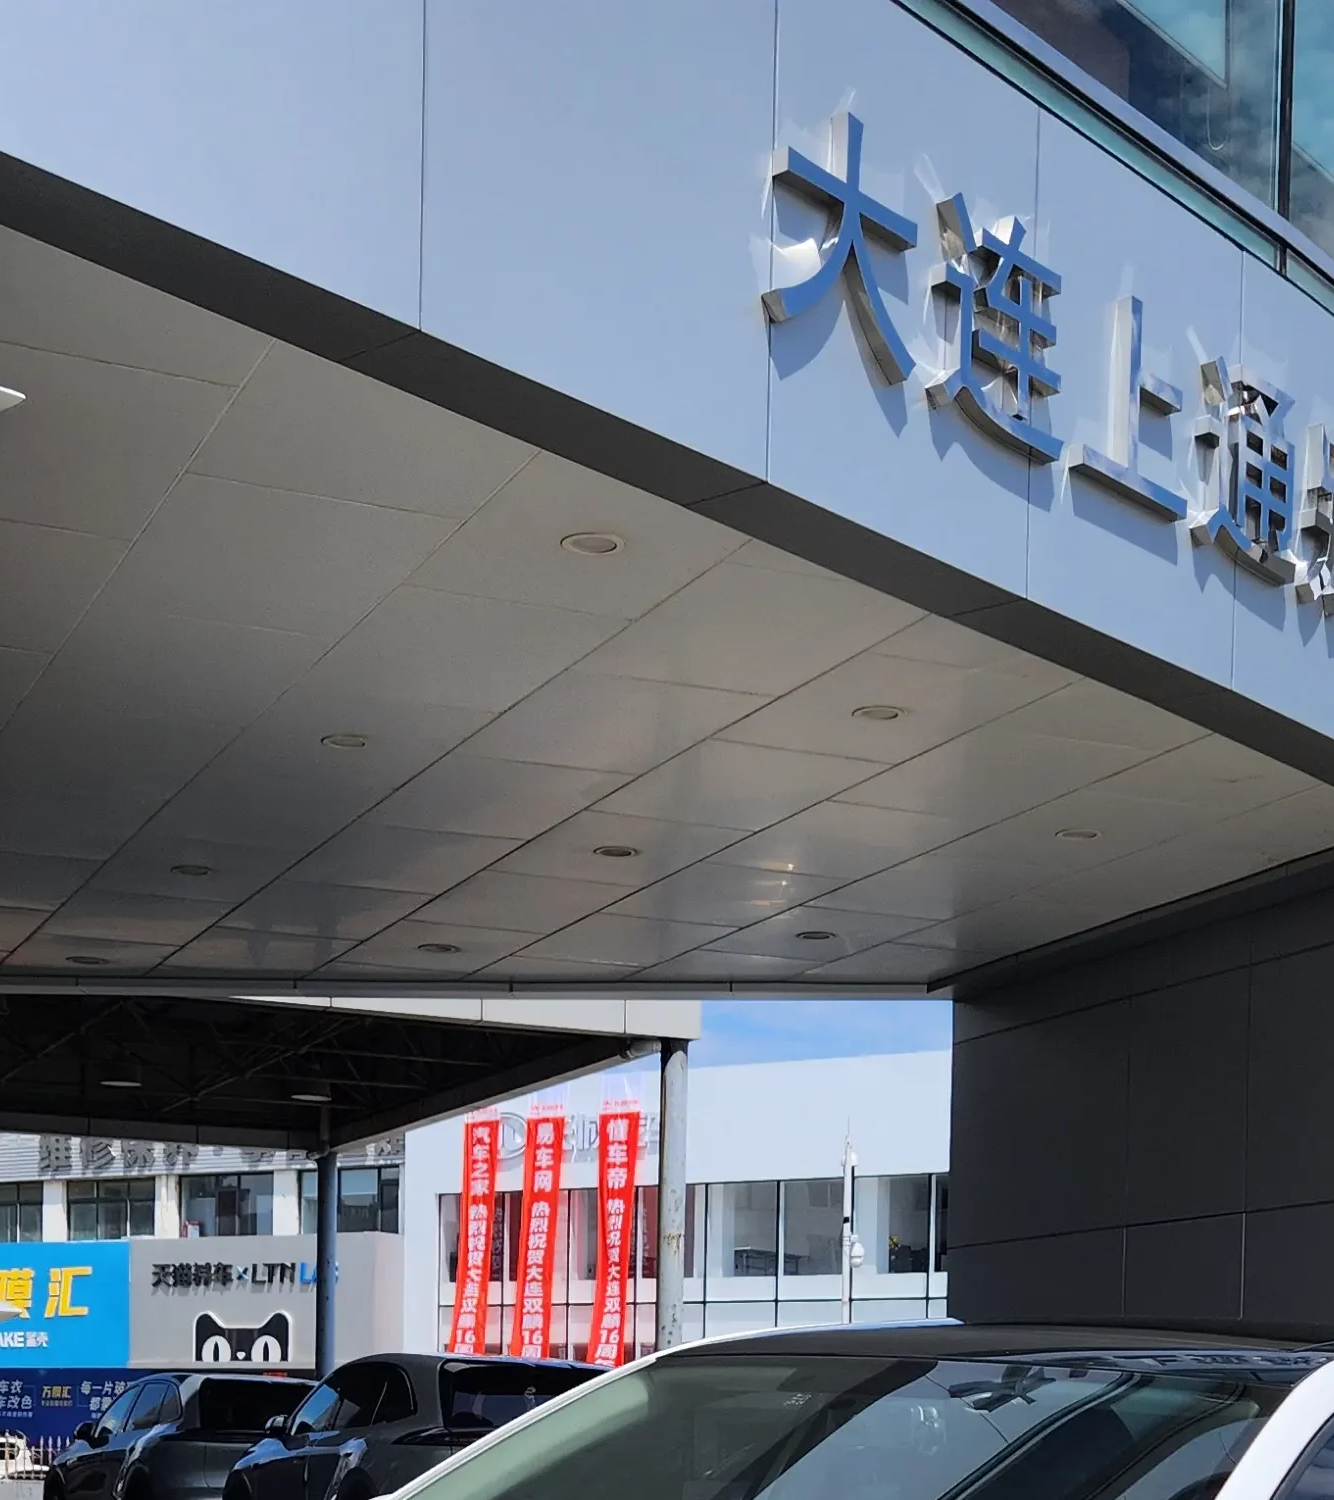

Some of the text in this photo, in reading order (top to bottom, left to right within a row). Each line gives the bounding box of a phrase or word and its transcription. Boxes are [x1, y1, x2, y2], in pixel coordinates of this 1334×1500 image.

[470, 1126, 491, 1197] 汽车之家
[533, 1122, 554, 1194] 易车网
[607, 1118, 629, 1190] 懂车帝
